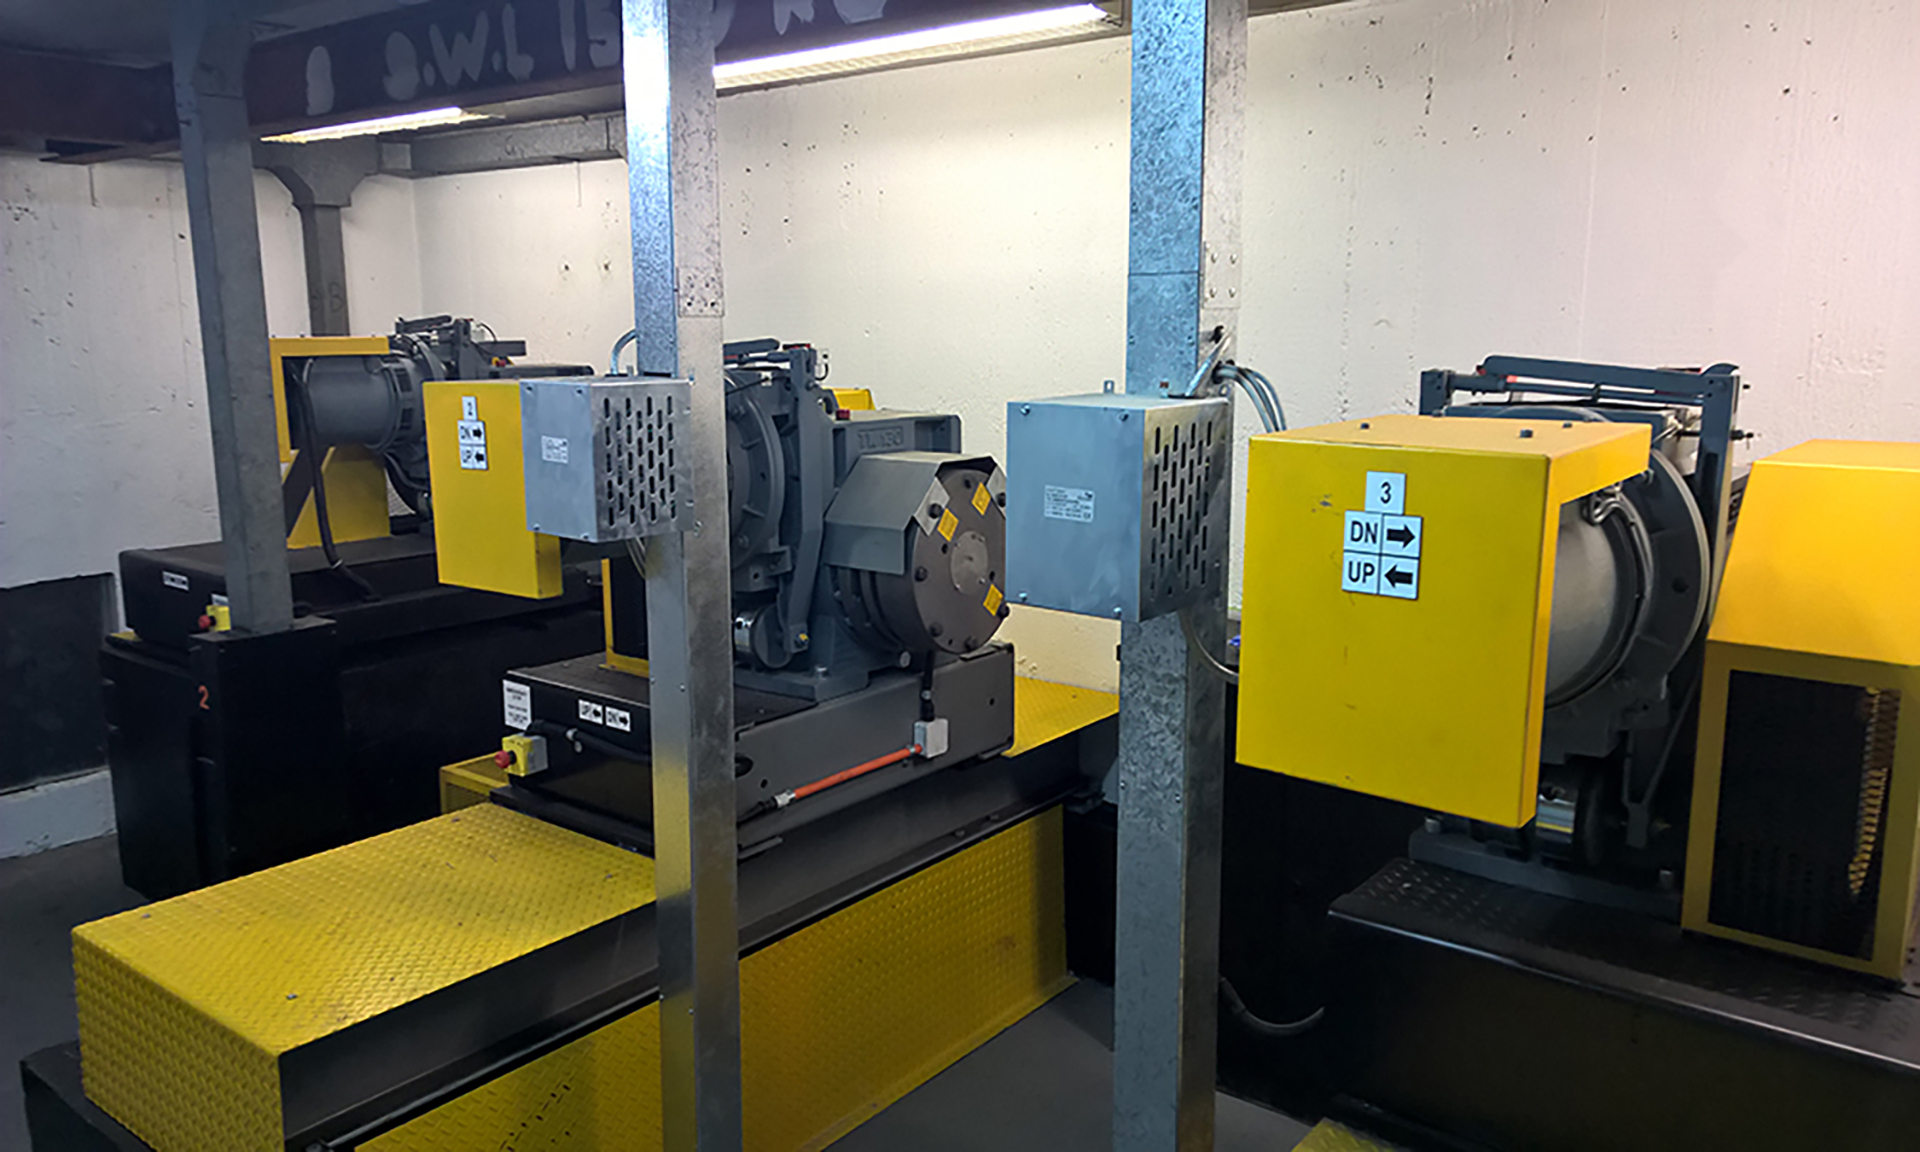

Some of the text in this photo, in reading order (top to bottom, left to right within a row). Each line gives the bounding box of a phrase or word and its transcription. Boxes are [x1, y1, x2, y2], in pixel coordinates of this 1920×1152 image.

[1380, 481, 1392, 504] 3
[1350, 520, 1379, 544] DN
[1348, 560, 1375, 584] UP
[198, 685, 210, 710] 2
